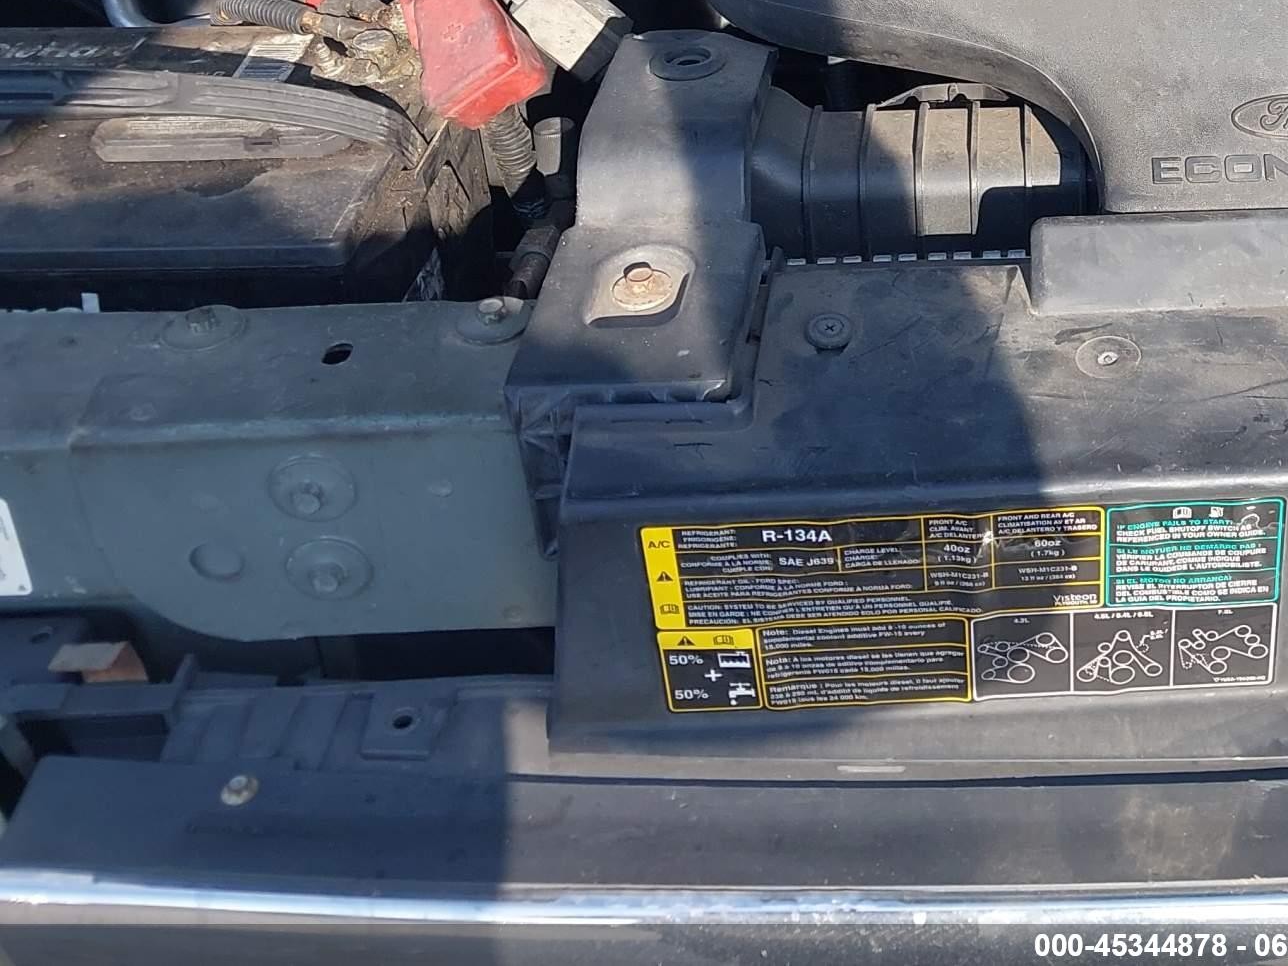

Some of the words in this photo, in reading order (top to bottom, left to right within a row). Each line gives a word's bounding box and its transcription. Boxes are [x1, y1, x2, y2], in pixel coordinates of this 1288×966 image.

[761, 529, 832, 543] R-134A
[648, 540, 671, 549] A/C
[944, 544, 971, 553] 40oz
[779, 557, 804, 566] SAE
[806, 557, 834, 567] J639
[1053, 594, 1097, 602] Visteon
[669, 654, 704, 666] 50%
[674, 688, 710, 701] 50%
